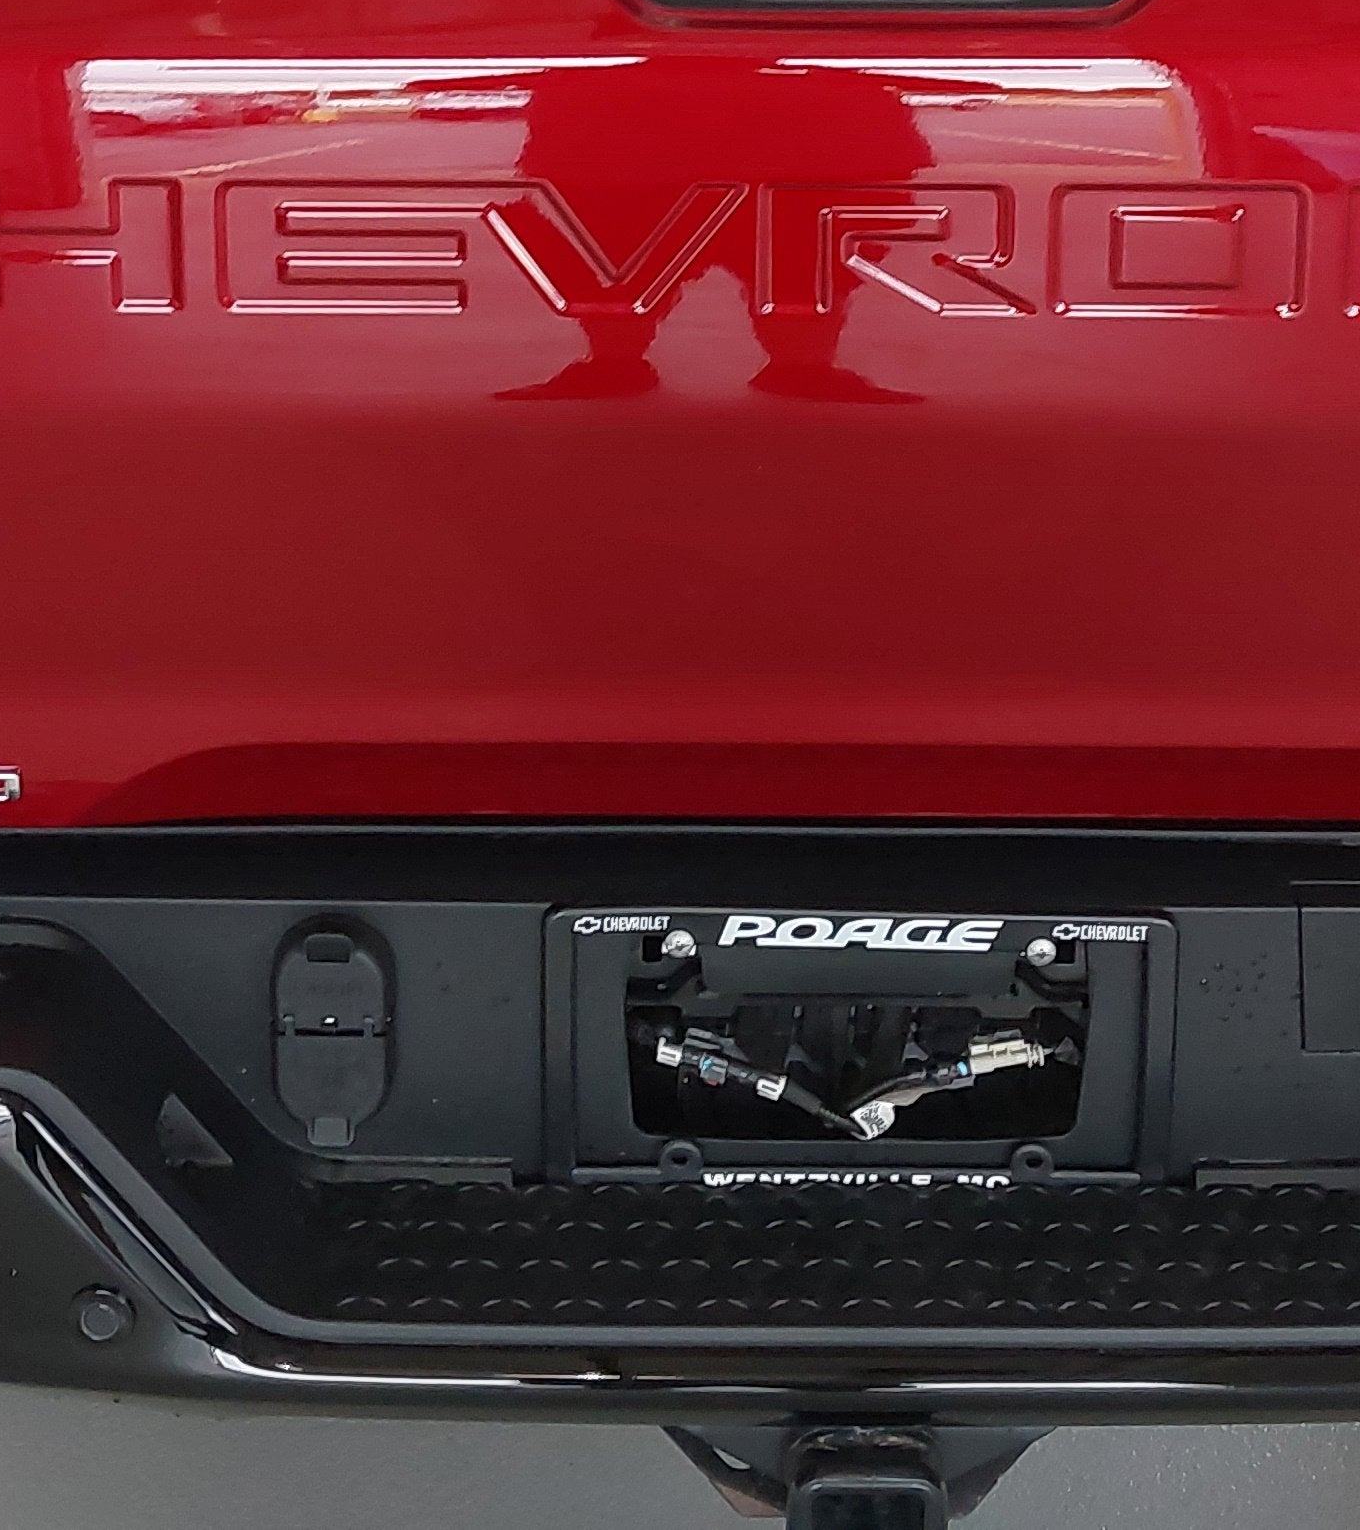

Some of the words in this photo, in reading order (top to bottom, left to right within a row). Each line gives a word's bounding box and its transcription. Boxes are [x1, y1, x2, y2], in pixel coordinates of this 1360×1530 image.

[602, 915, 670, 932] CHEVROLET
[716, 915, 1005, 952] POAGE
[1080, 924, 1149, 942] CHEVROLET
